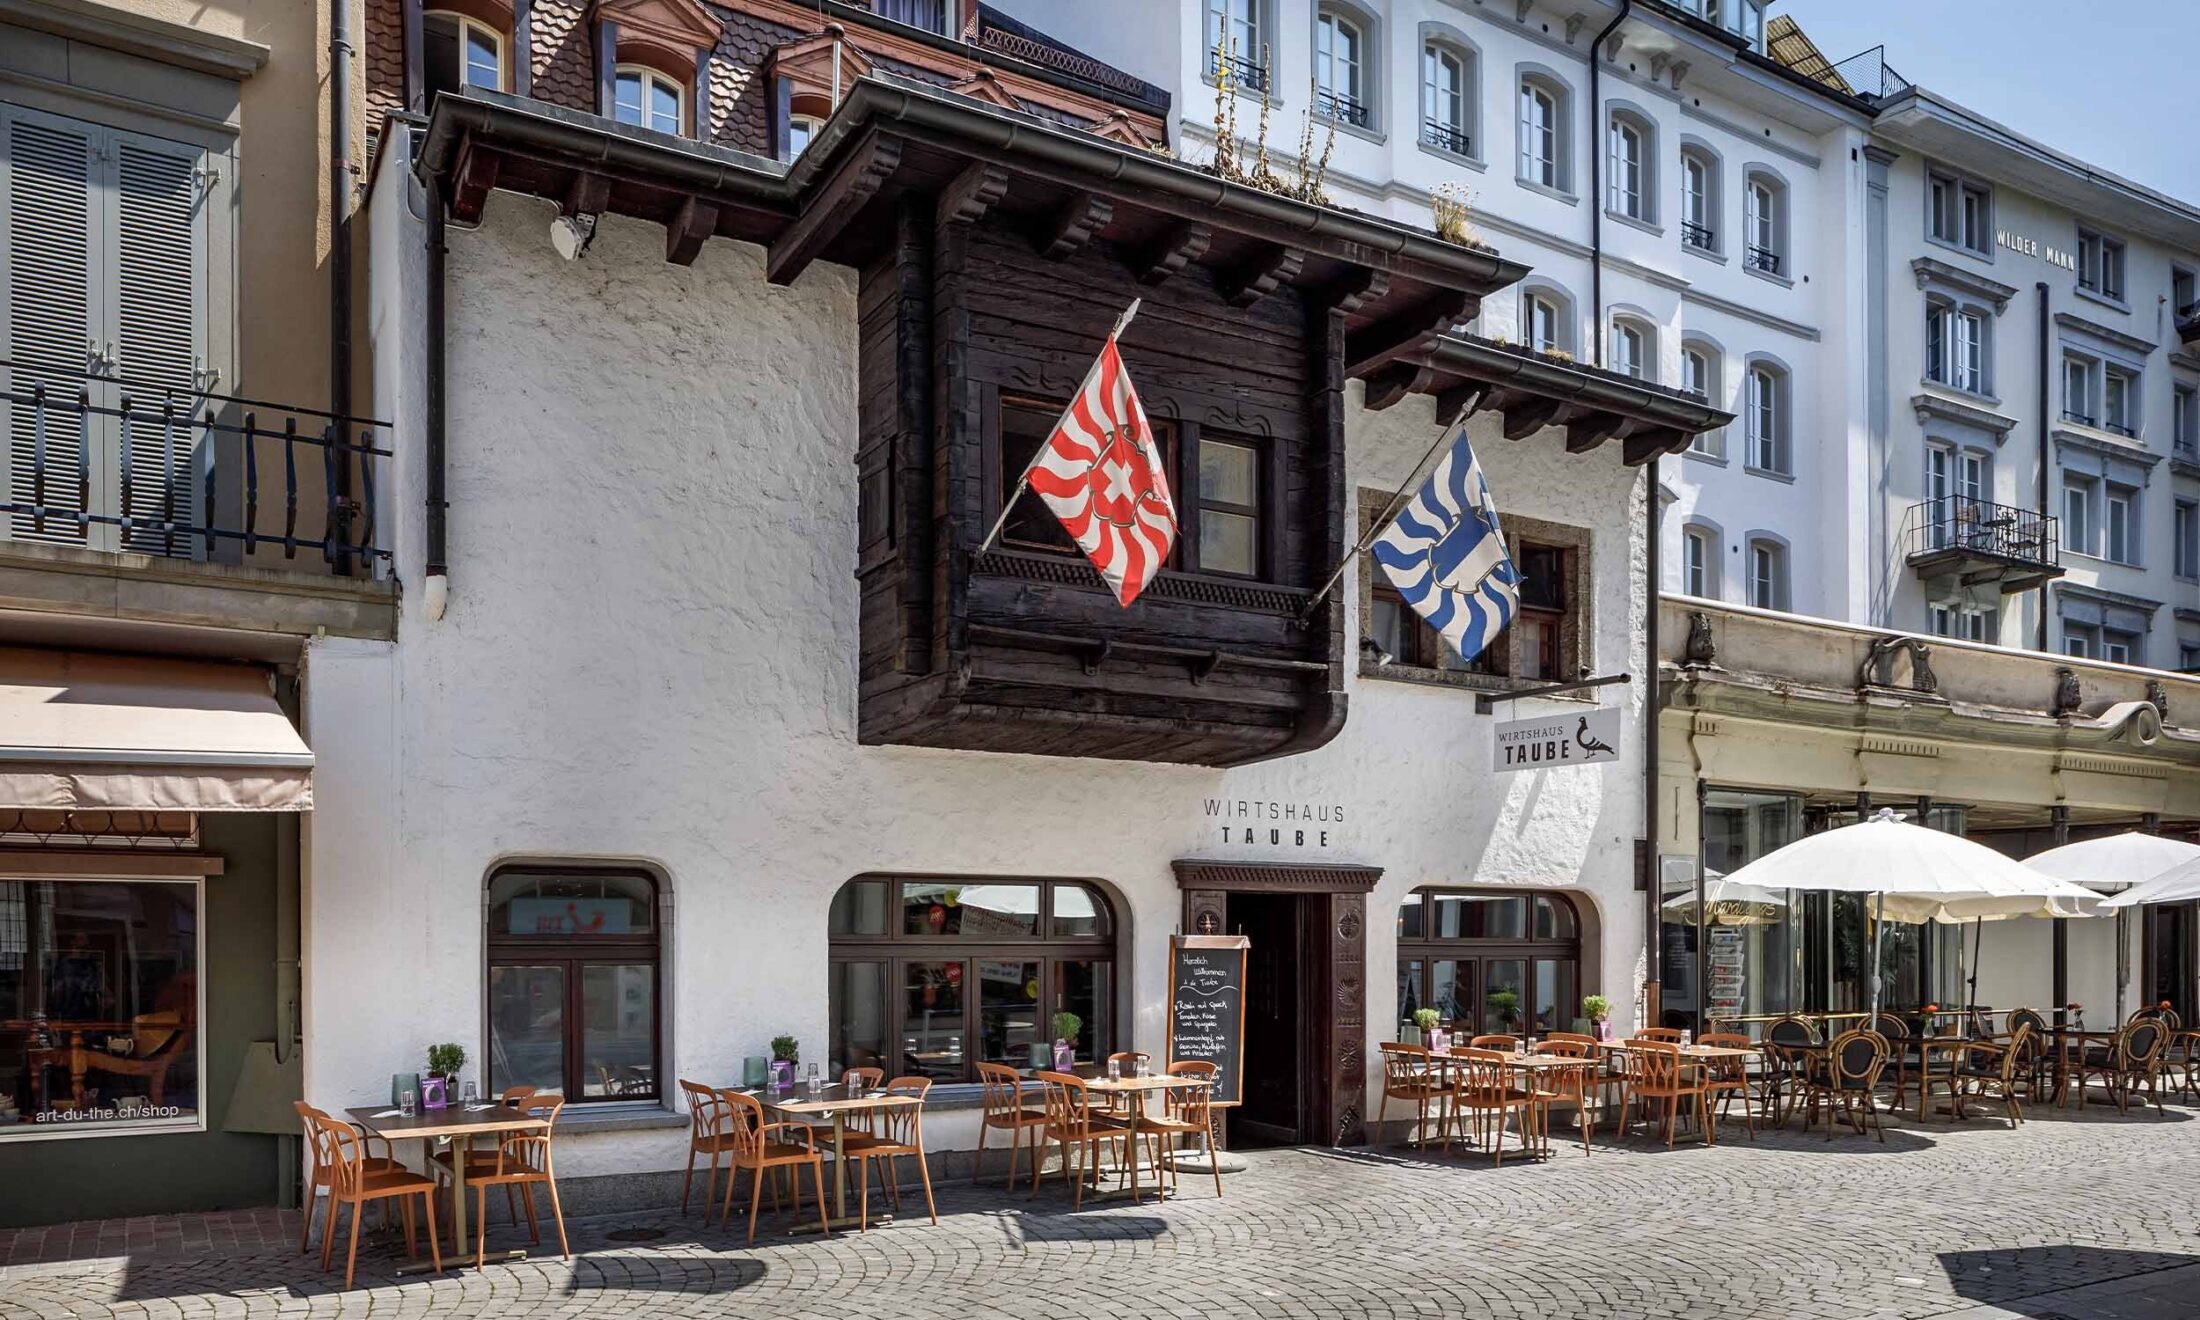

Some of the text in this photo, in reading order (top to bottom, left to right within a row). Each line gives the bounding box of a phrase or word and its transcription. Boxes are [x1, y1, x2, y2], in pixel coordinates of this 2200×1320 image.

[1996, 229, 2075, 271] WILDER MANN
[1498, 726, 1563, 742] WIRTSHAUS
[1505, 740, 1569, 764] TAUBE
[1204, 799, 1344, 822] WIRTSHAUS
[1222, 827, 1327, 846] TAUBE
[36, 1105, 179, 1122] art-du-the.ch/shop
